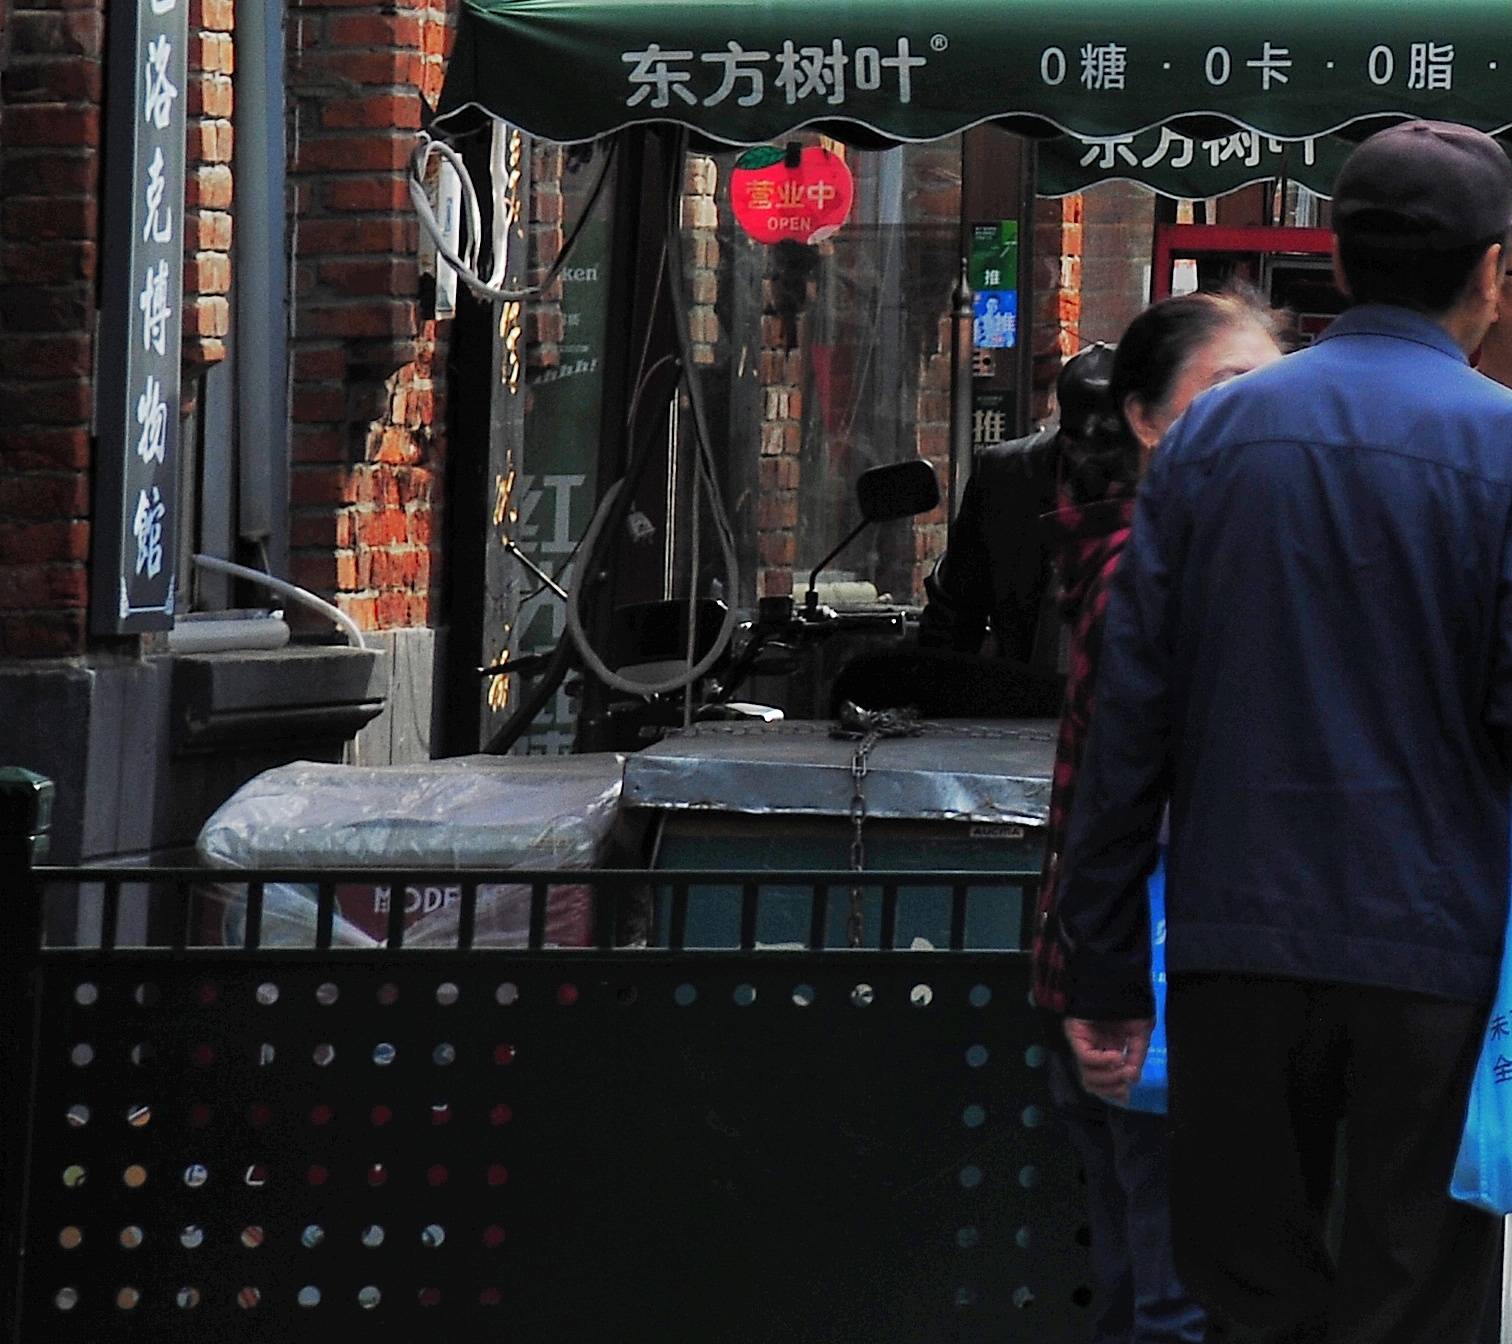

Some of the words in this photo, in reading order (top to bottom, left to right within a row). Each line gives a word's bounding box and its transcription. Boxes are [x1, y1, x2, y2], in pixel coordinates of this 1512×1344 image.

[621, 37, 926, 109] 东方树叶
[745, 180, 836, 210] 营业中
[766, 215, 811, 232] OPEN
